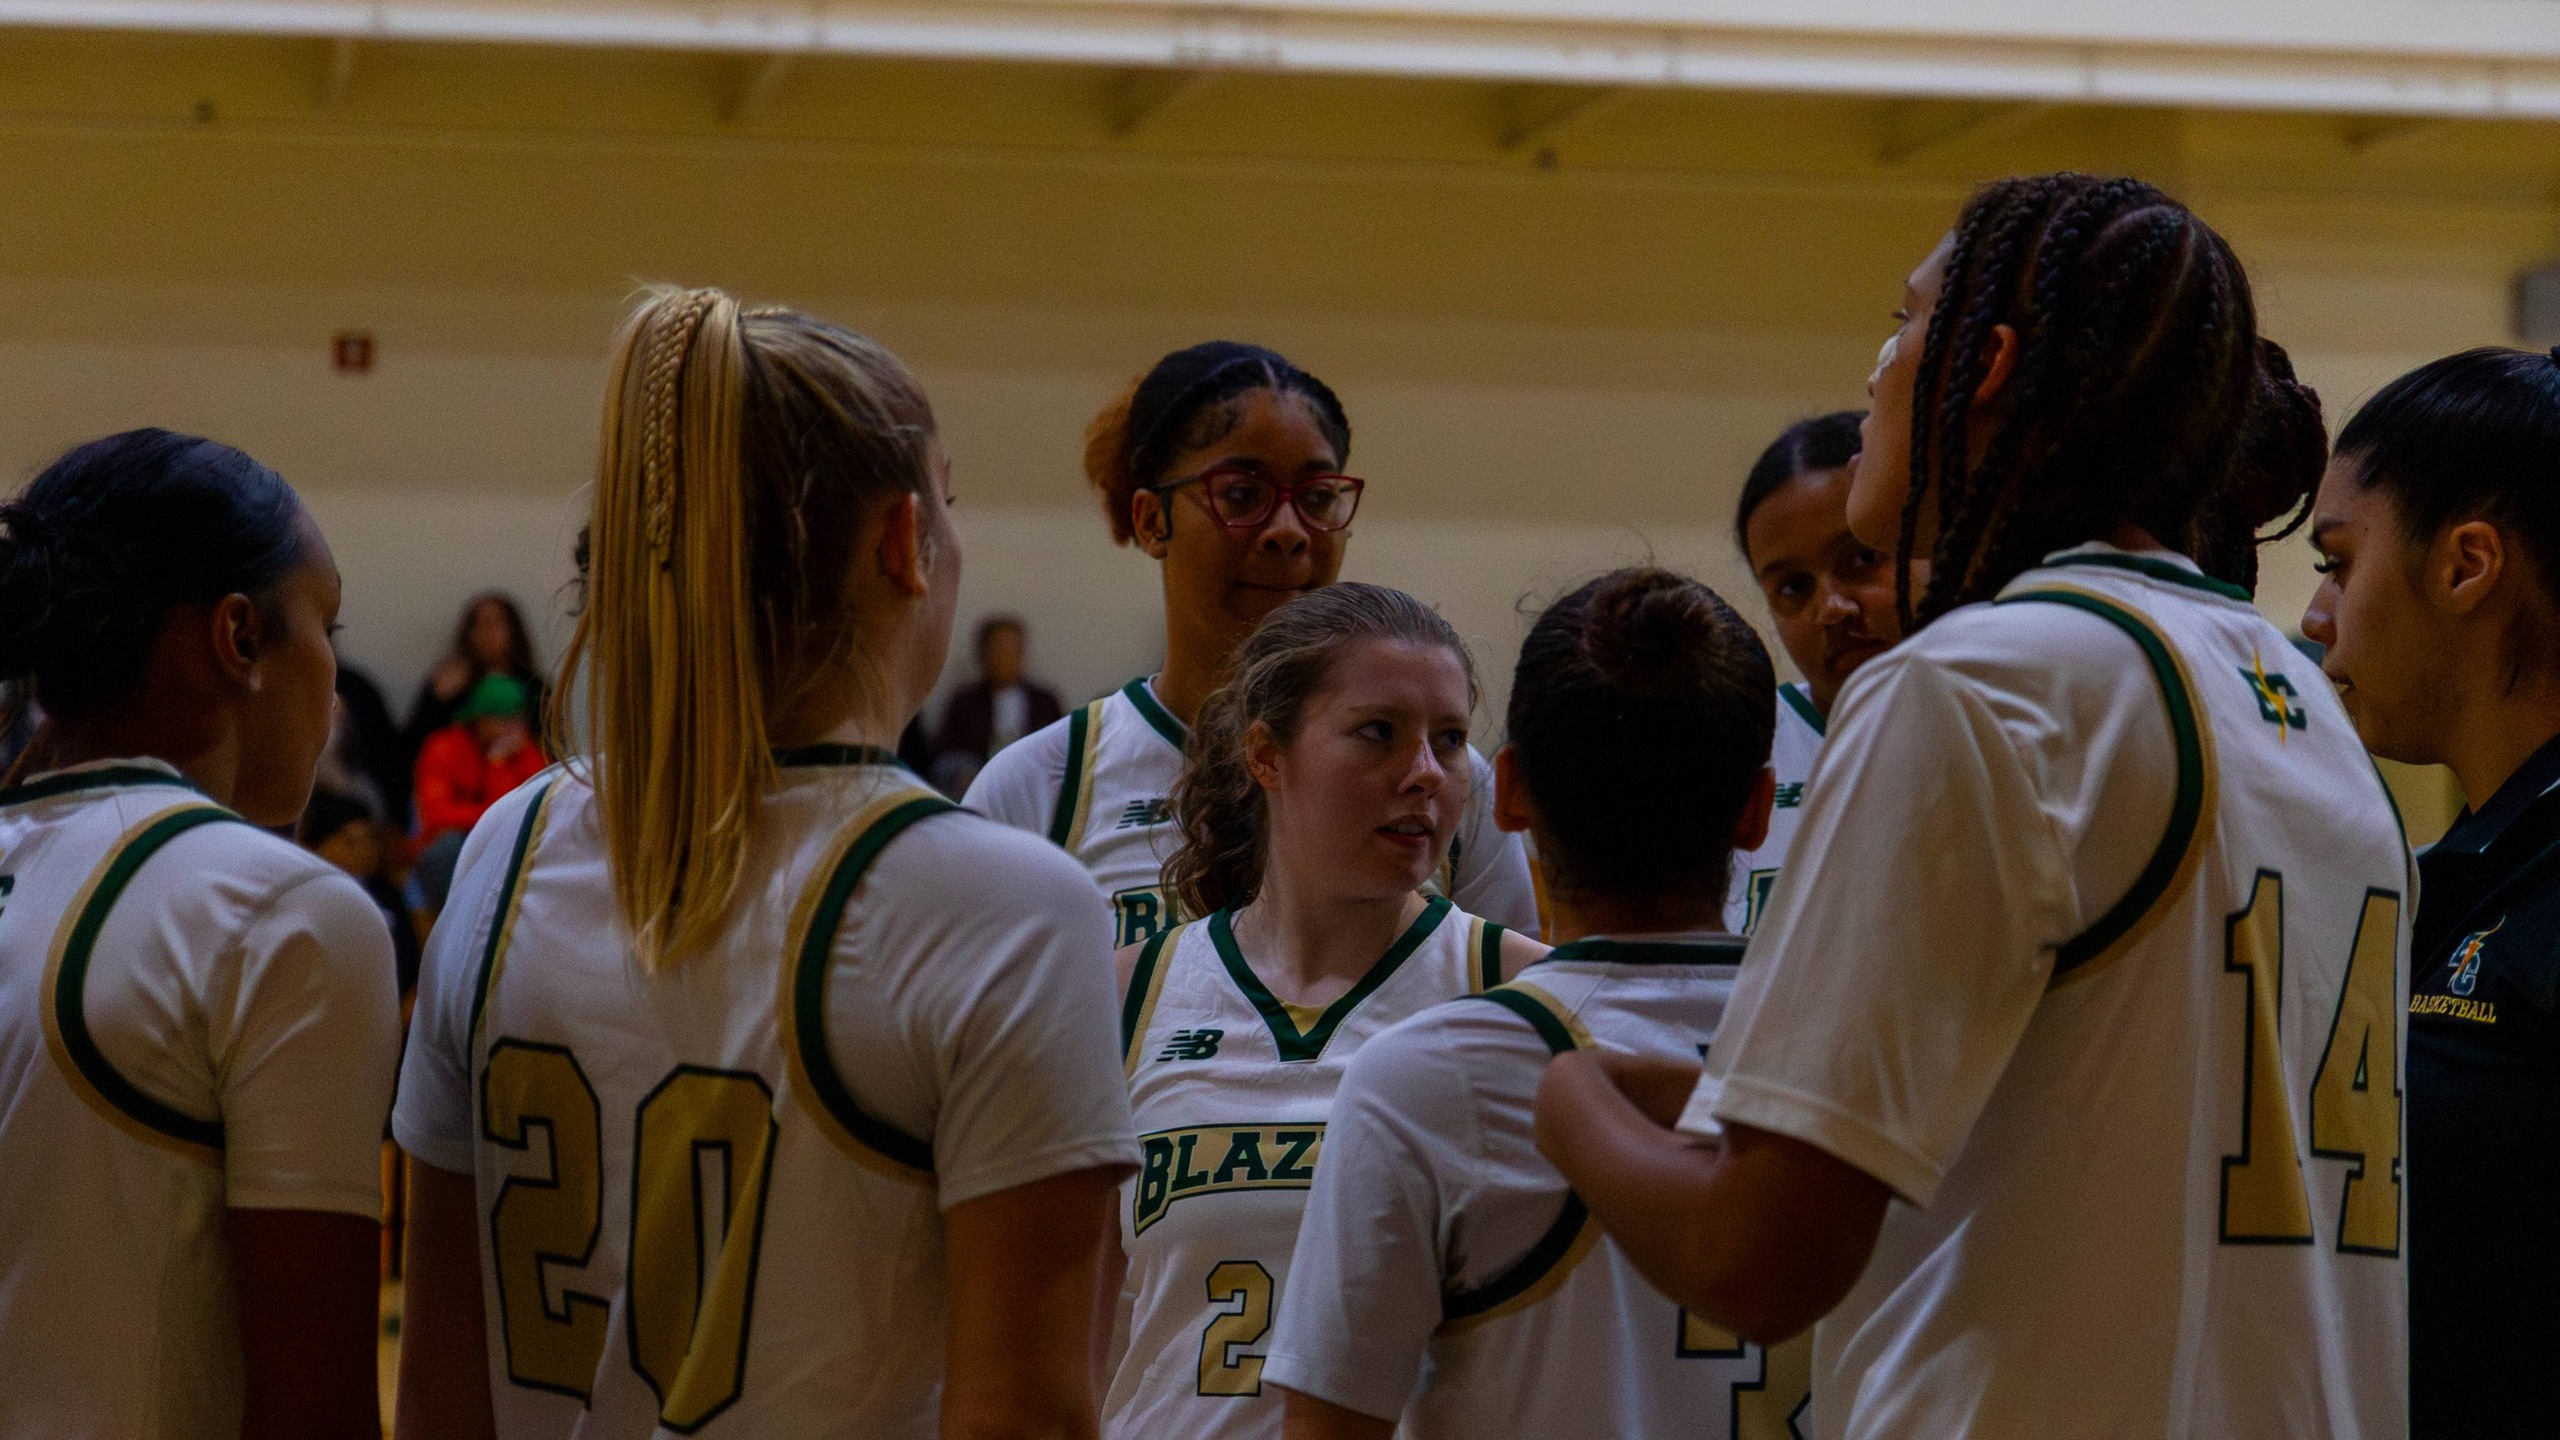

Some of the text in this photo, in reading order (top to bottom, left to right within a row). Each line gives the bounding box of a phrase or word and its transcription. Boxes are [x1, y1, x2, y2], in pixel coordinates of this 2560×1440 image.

[2220, 867, 2402, 1258] 14
[2409, 993, 2498, 1025] BASKETBALL
[481, 1036, 779, 1434] 20
[1138, 1131, 1326, 1223] BLAZ
[1197, 1260, 1274, 1397] 2
